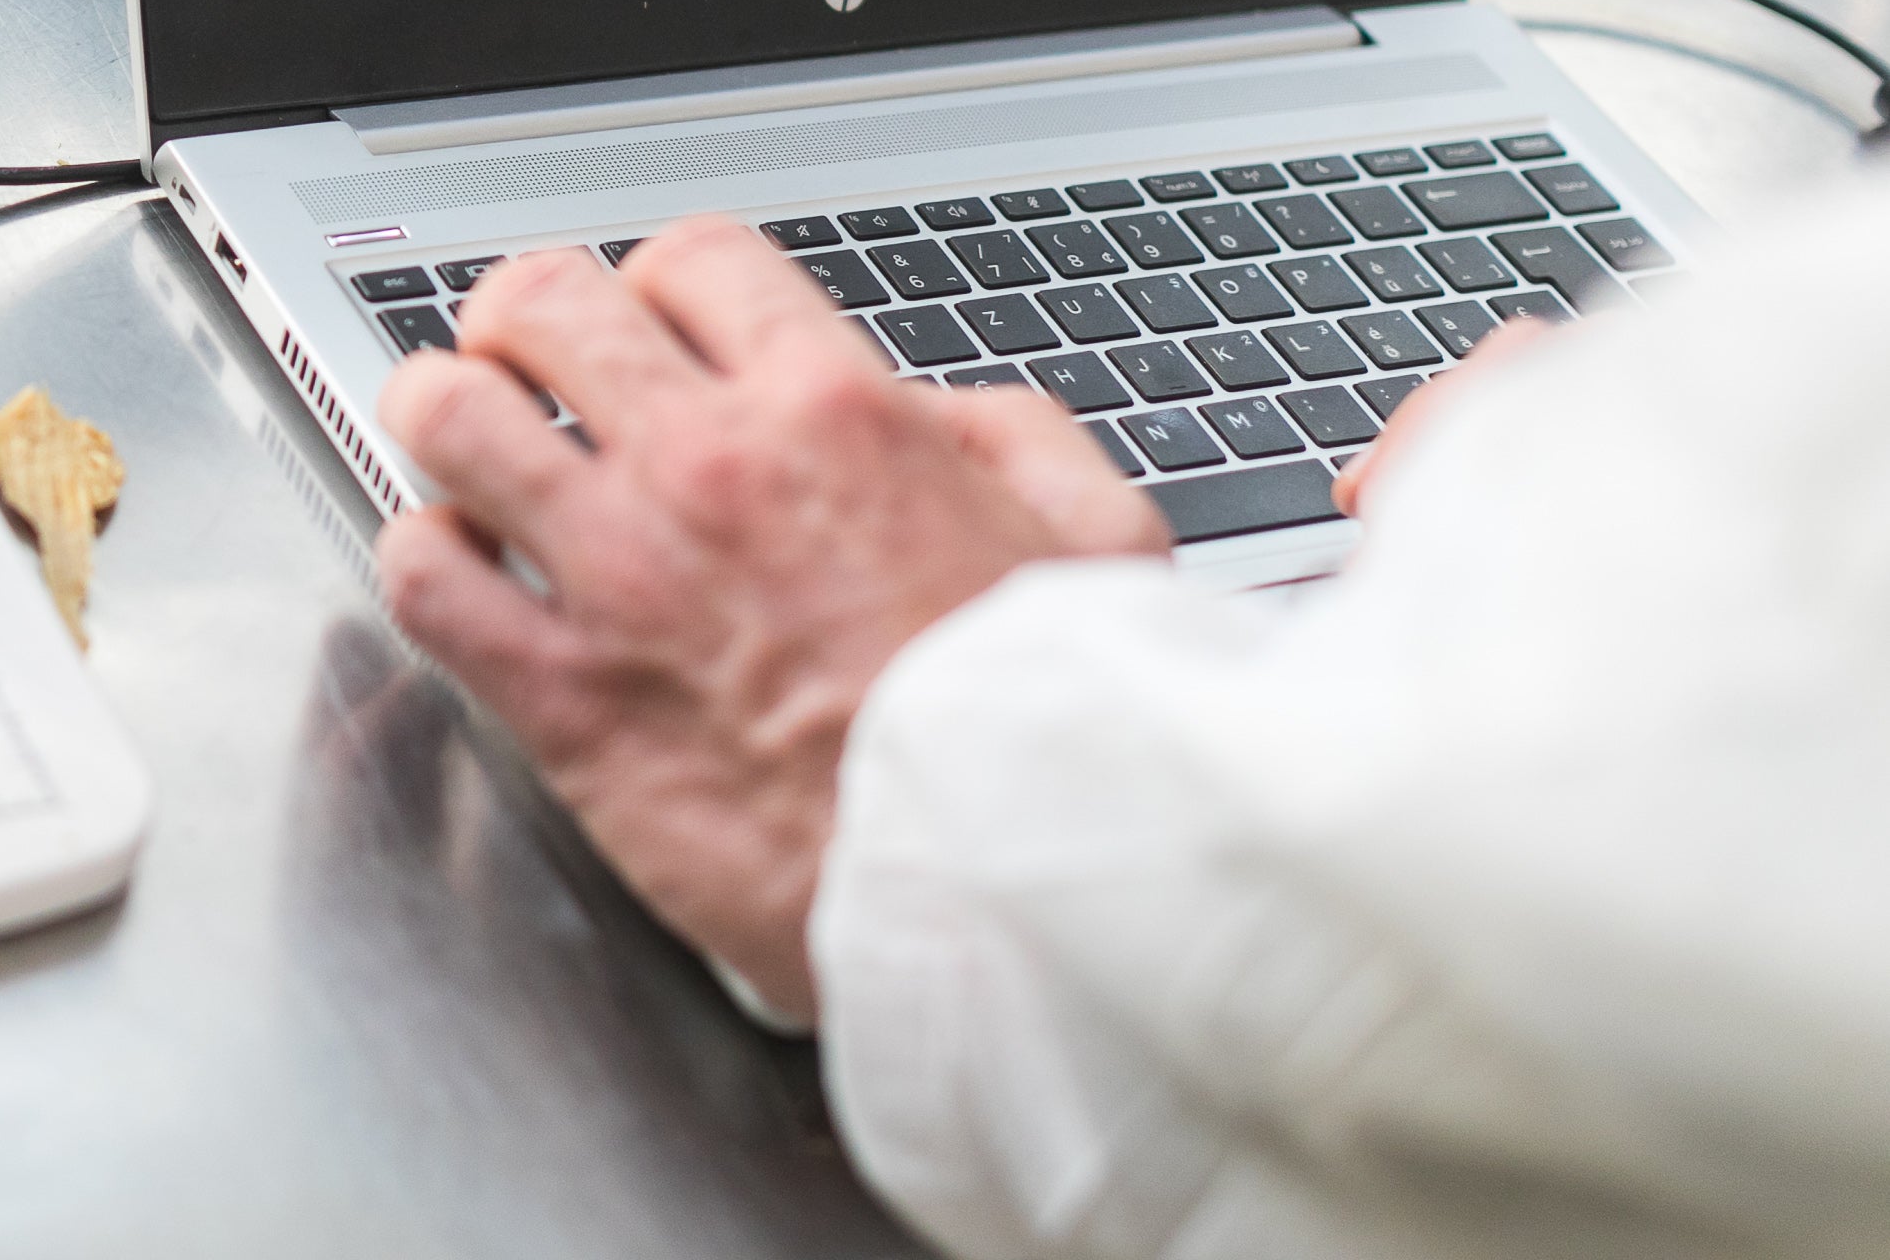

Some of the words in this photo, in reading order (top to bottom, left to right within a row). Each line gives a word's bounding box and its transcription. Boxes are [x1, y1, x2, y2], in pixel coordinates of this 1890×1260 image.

[1143, 245, 1160, 258] 9
[1066, 254, 1084, 267] 8
[987, 264, 1000, 278] 7
[1292, 269, 1309, 286] P
[383, 275, 408, 288] esc
[909, 276, 925, 289] 6
[1220, 280, 1240, 295] O
[827, 285, 844, 300] 5
[1061, 299, 1082, 315] U
[982, 310, 1004, 326] Z
[899, 321, 916, 337] T
[1289, 336, 1311, 352] L
[1212, 346, 1237, 362] K
[1138, 357, 1150, 373] J
[1053, 368, 1076, 385] H
[1226, 411, 1252, 430] M
[1145, 424, 1170, 441] N
